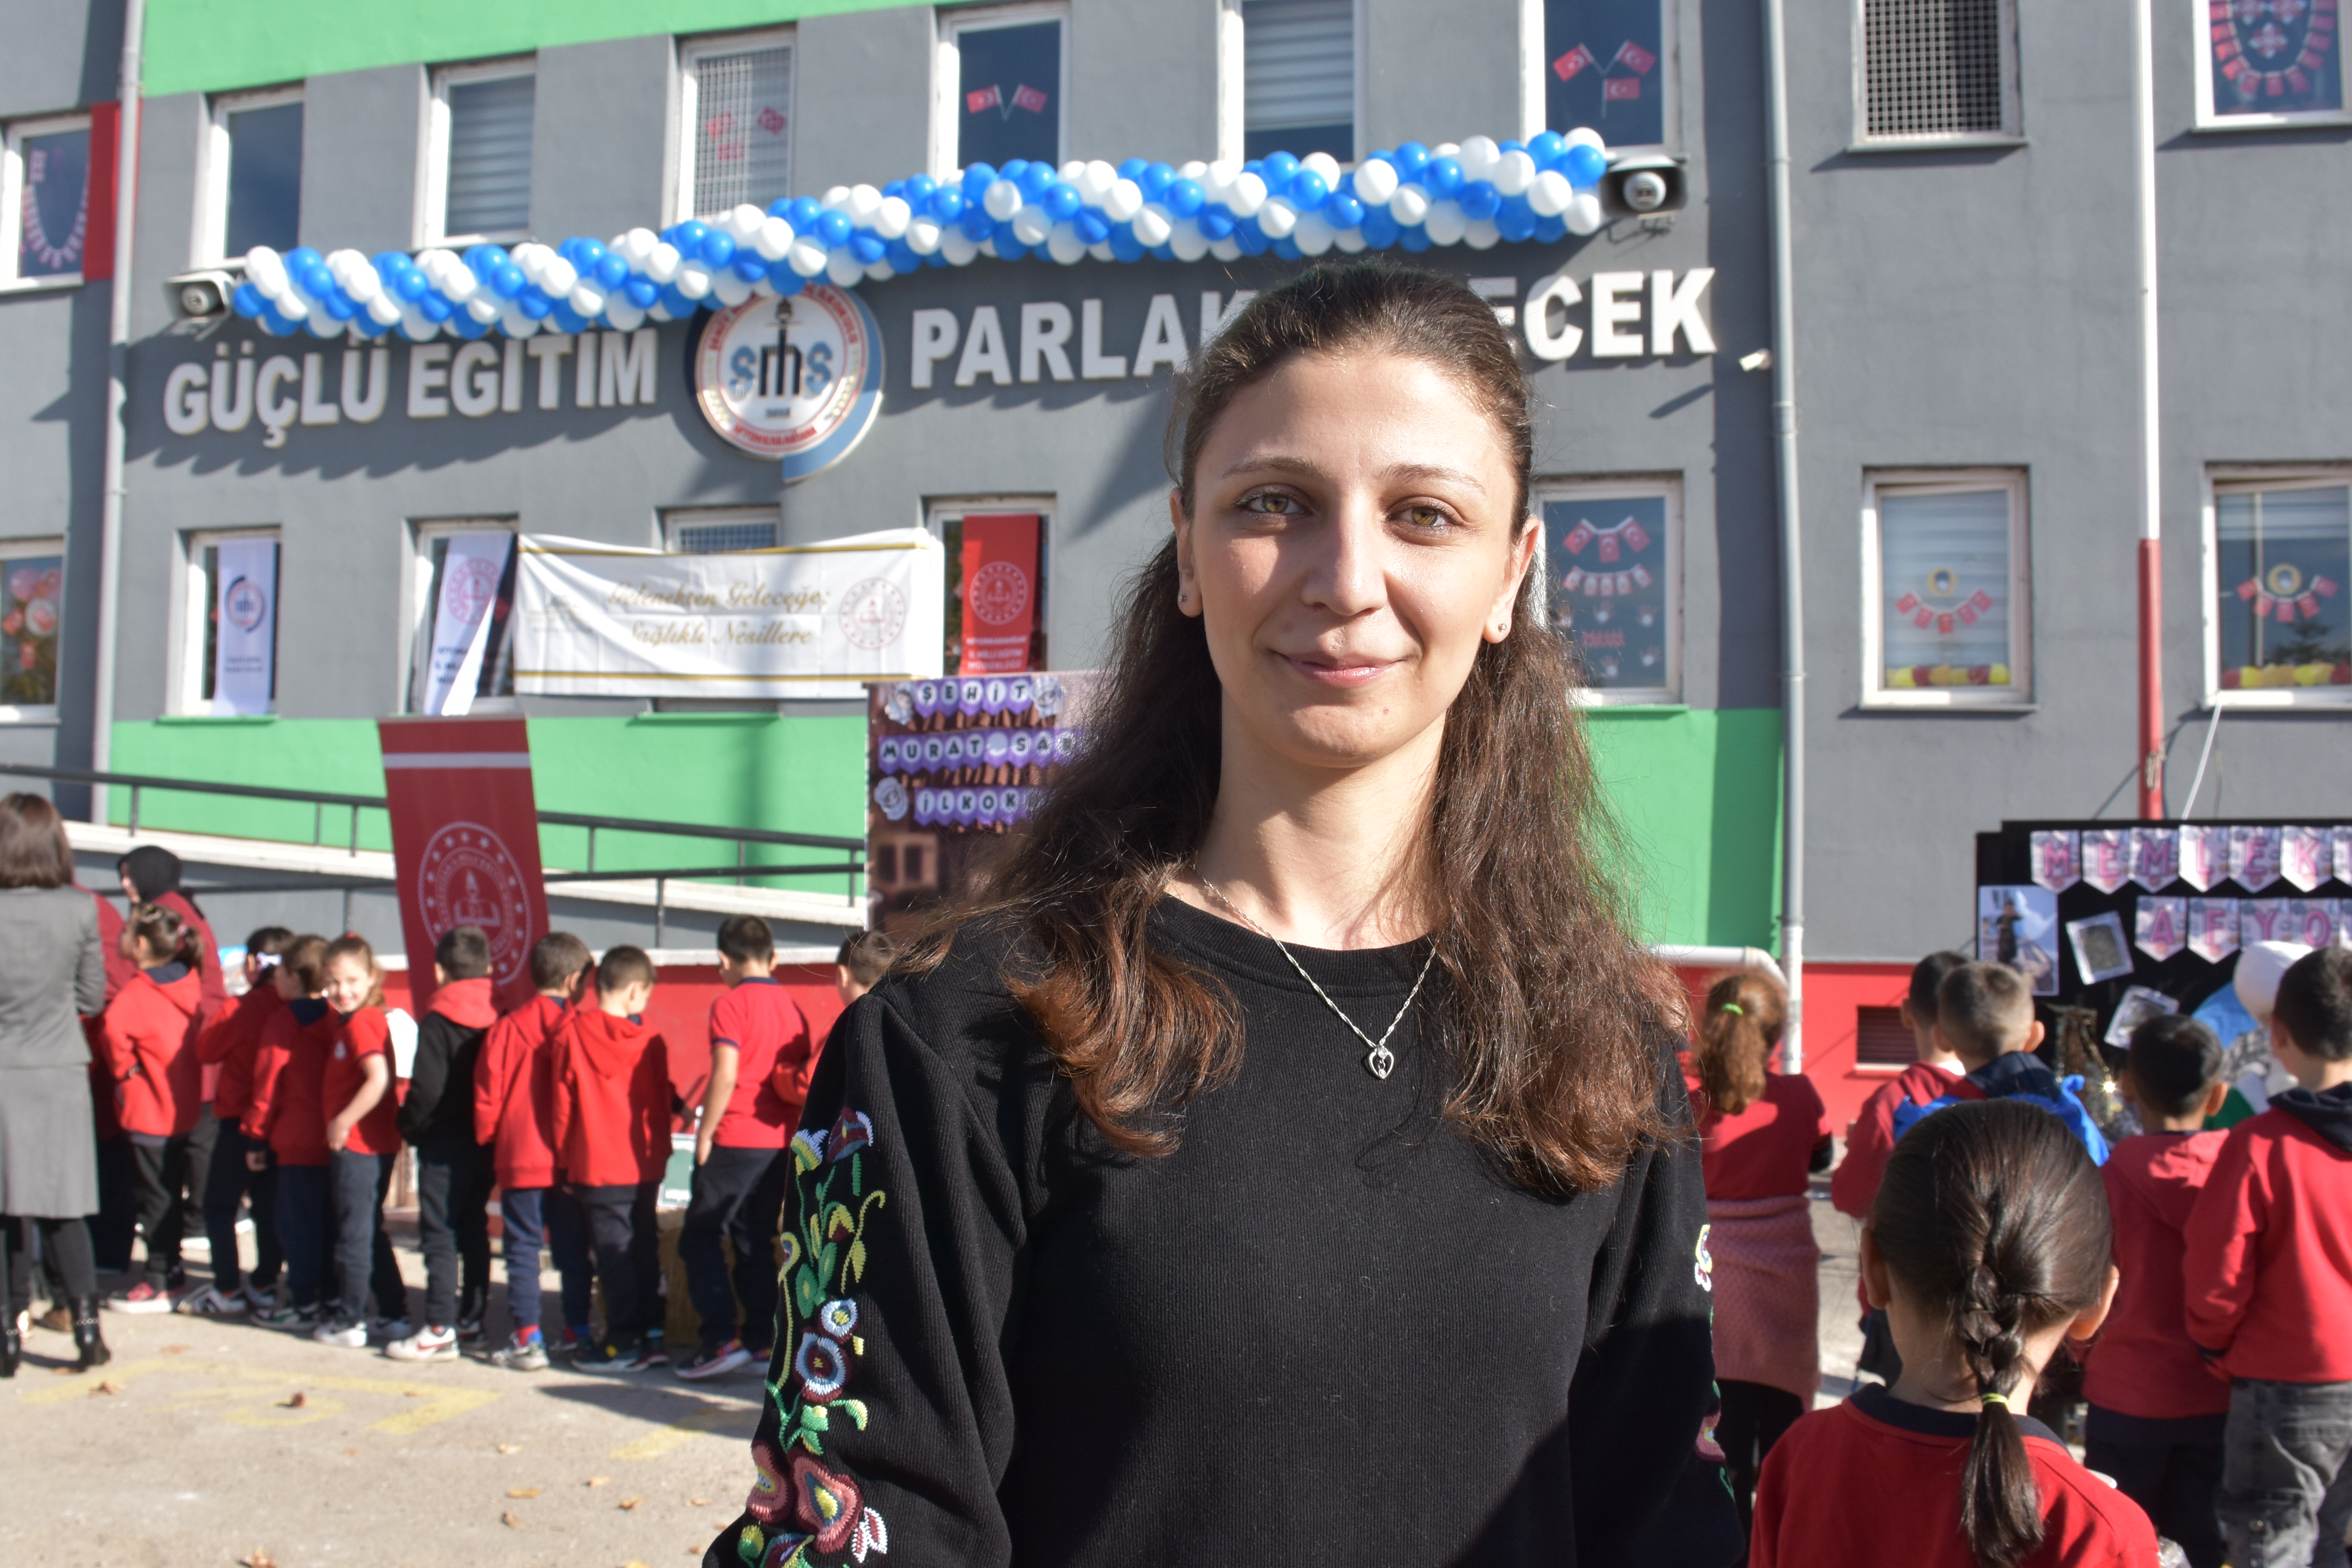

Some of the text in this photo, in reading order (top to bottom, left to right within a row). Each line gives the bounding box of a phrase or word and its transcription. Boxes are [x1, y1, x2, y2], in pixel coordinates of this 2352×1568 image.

[163, 334, 390, 448] GÜÇLÜ
[883, 738, 980, 759] MURAT
[922, 792, 1040, 810] İLKOK
[2044, 836, 2352, 879] MEMLEK
